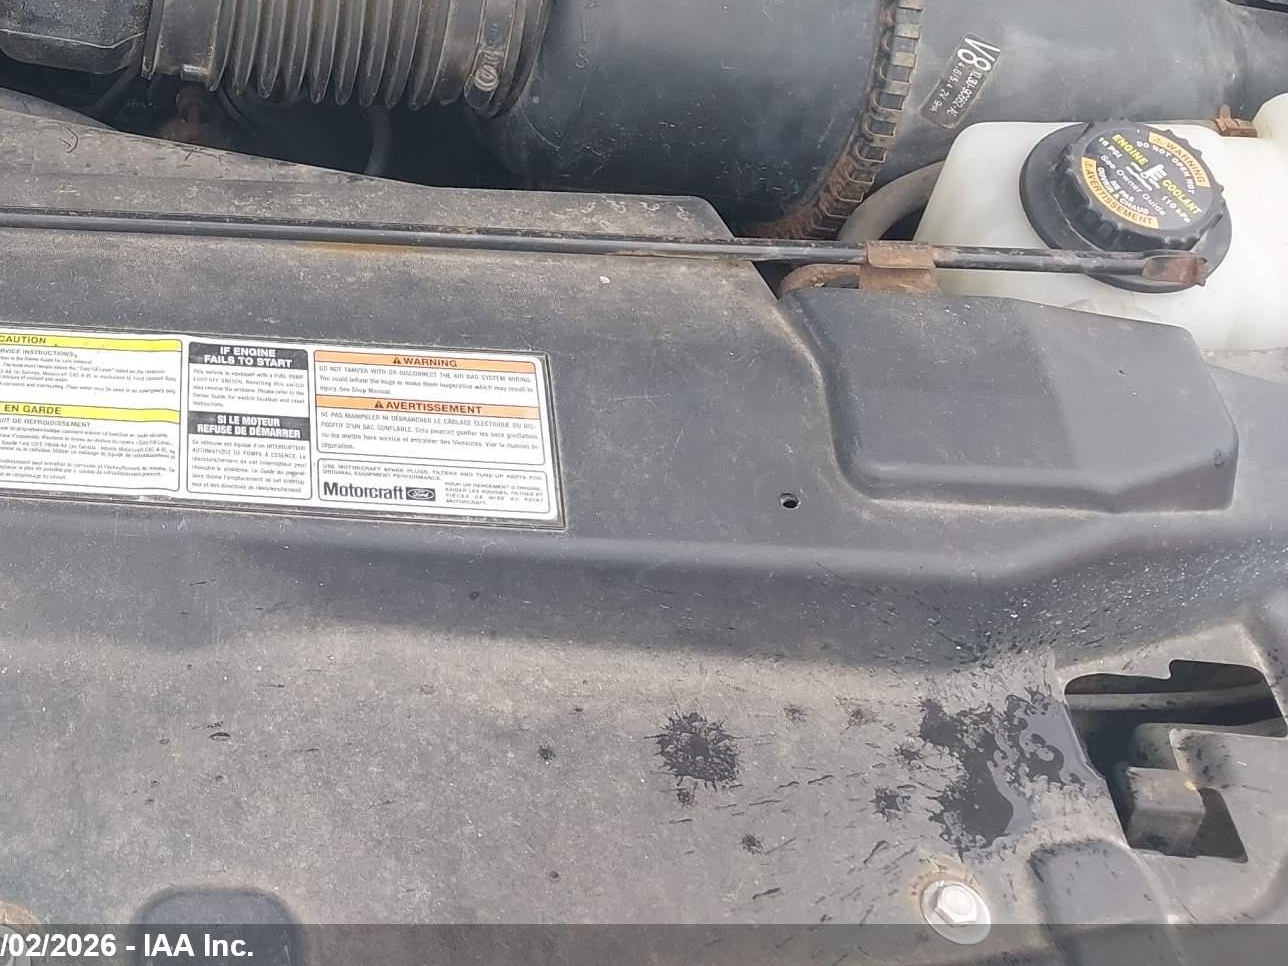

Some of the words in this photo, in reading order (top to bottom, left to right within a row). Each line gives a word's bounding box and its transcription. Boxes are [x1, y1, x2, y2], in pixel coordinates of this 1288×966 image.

[957, 37, 1001, 71] V8
[1098, 137, 1109, 146] 16
[1107, 145, 1123, 158] PSI
[1112, 133, 1149, 165] ENGINE
[1136, 140, 1150, 149] DO
[1152, 144, 1172, 157] NOT
[1171, 157, 1193, 177] OPEN
[1166, 141, 1207, 184] WARNING
[1101, 155, 1116, 169] See
[1116, 169, 1143, 193] Owner
[1142, 193, 1166, 215] Guide
[1111, 180, 1122, 191] NE
[1119, 190, 1135, 202] PAS
[1085, 171, 1152, 224] AVERTISSEMENT
[1162, 179, 1202, 214] COOLANT
[1162, 195, 1177, 209] 110
[1119, 197, 1149, 215] CHAUD
[219, 346, 231, 355] IF
[233, 347, 276, 358] ENGINE
[203, 354, 236, 365] FAILS
[238, 356, 254, 366] TO
[256, 357, 292, 369] START
[403, 357, 458, 368] WARNING
[399, 370, 437, 378] DISCONNECT
[4, 404, 19, 413] EN
[23, 405, 62, 415] GARDE
[385, 401, 483, 415] AVERTISSEMENT
[24, 418, 91, 428] REFROIDISSEMENT
[217, 414, 227, 425] SI
[229, 415, 240, 425] LE
[242, 416, 281, 428] MOTEUR
[197, 424, 233, 435] REFUSE
[234, 425, 248, 436] DE
[249, 425, 301, 439] DÉMARRER
[323, 481, 404, 500] Motorcraft
[409, 490, 432, 499] Ford
